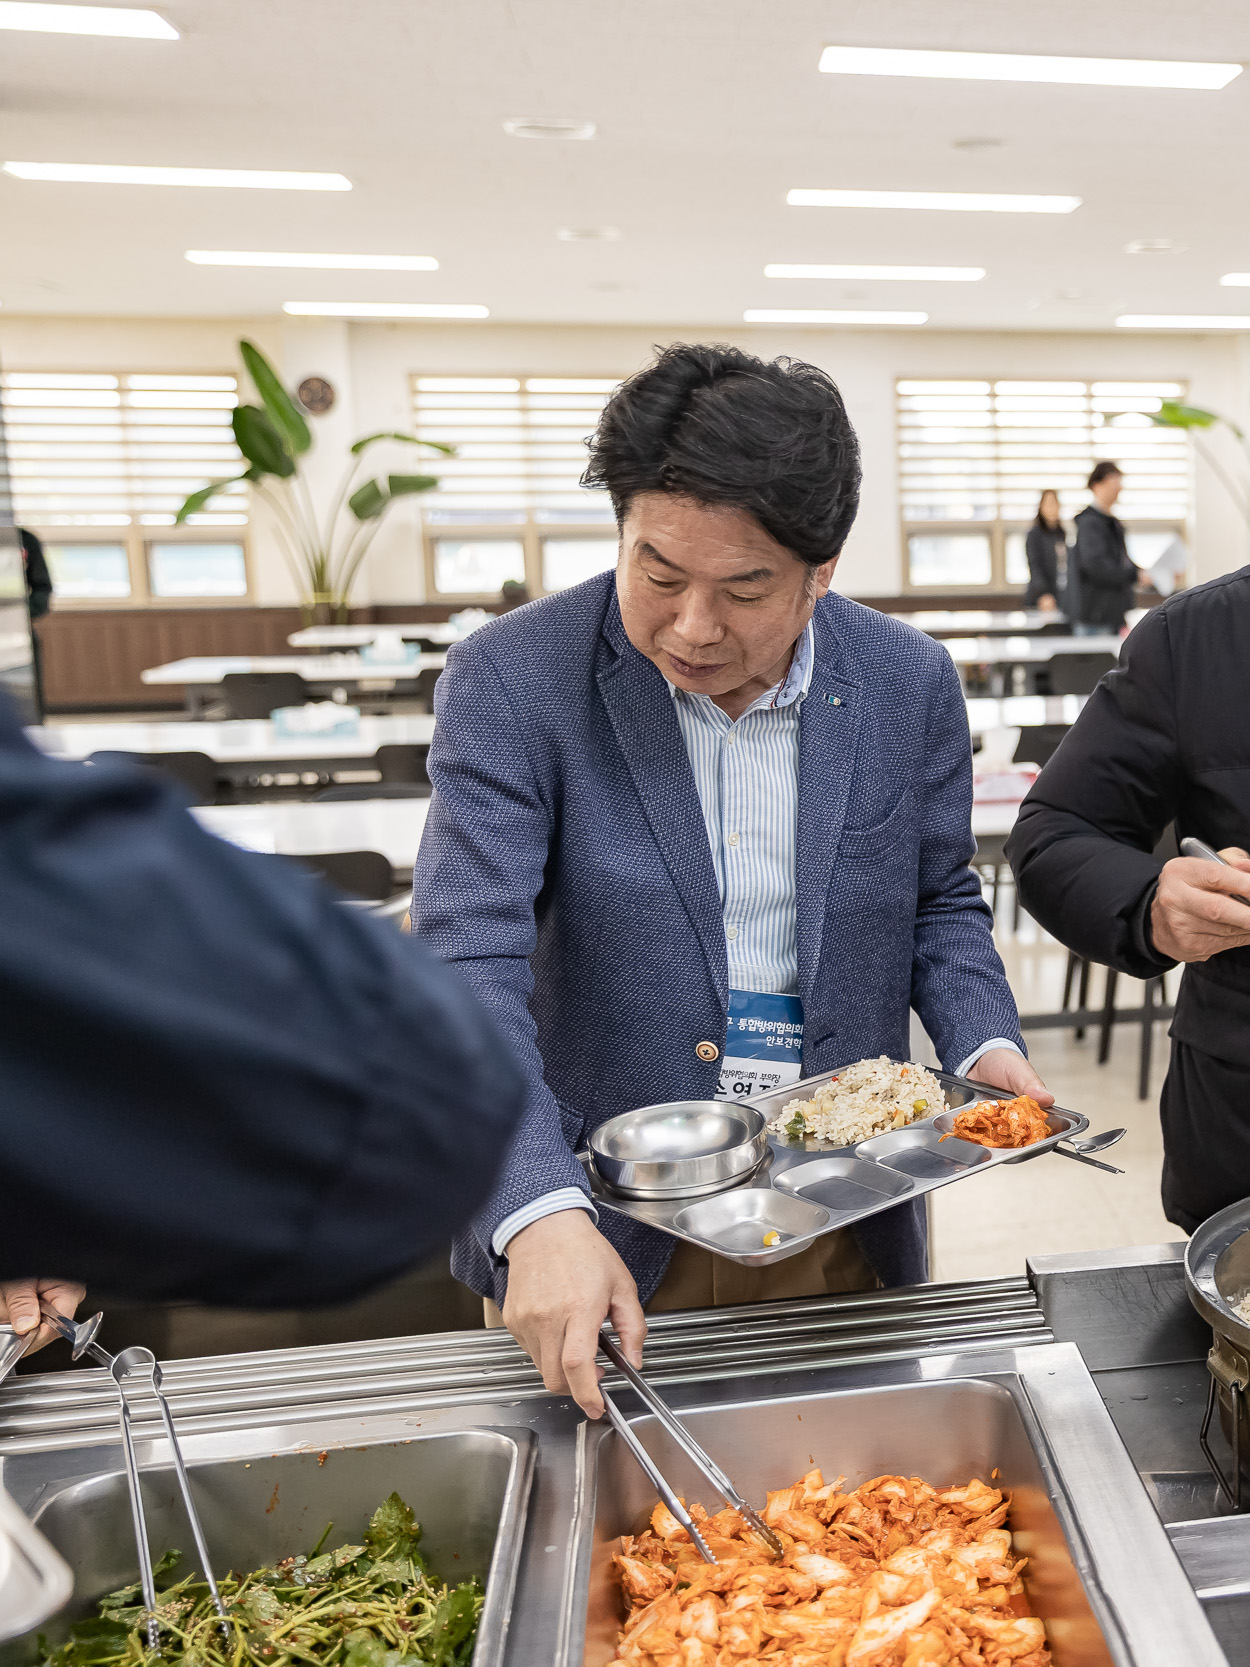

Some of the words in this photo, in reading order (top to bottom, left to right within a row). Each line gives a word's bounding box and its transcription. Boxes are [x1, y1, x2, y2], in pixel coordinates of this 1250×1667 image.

[737, 1018, 804, 1035] 통합방위협의회
[766, 1035, 803, 1050] 안보견학
[720, 1069, 758, 1080] 방위협의회
